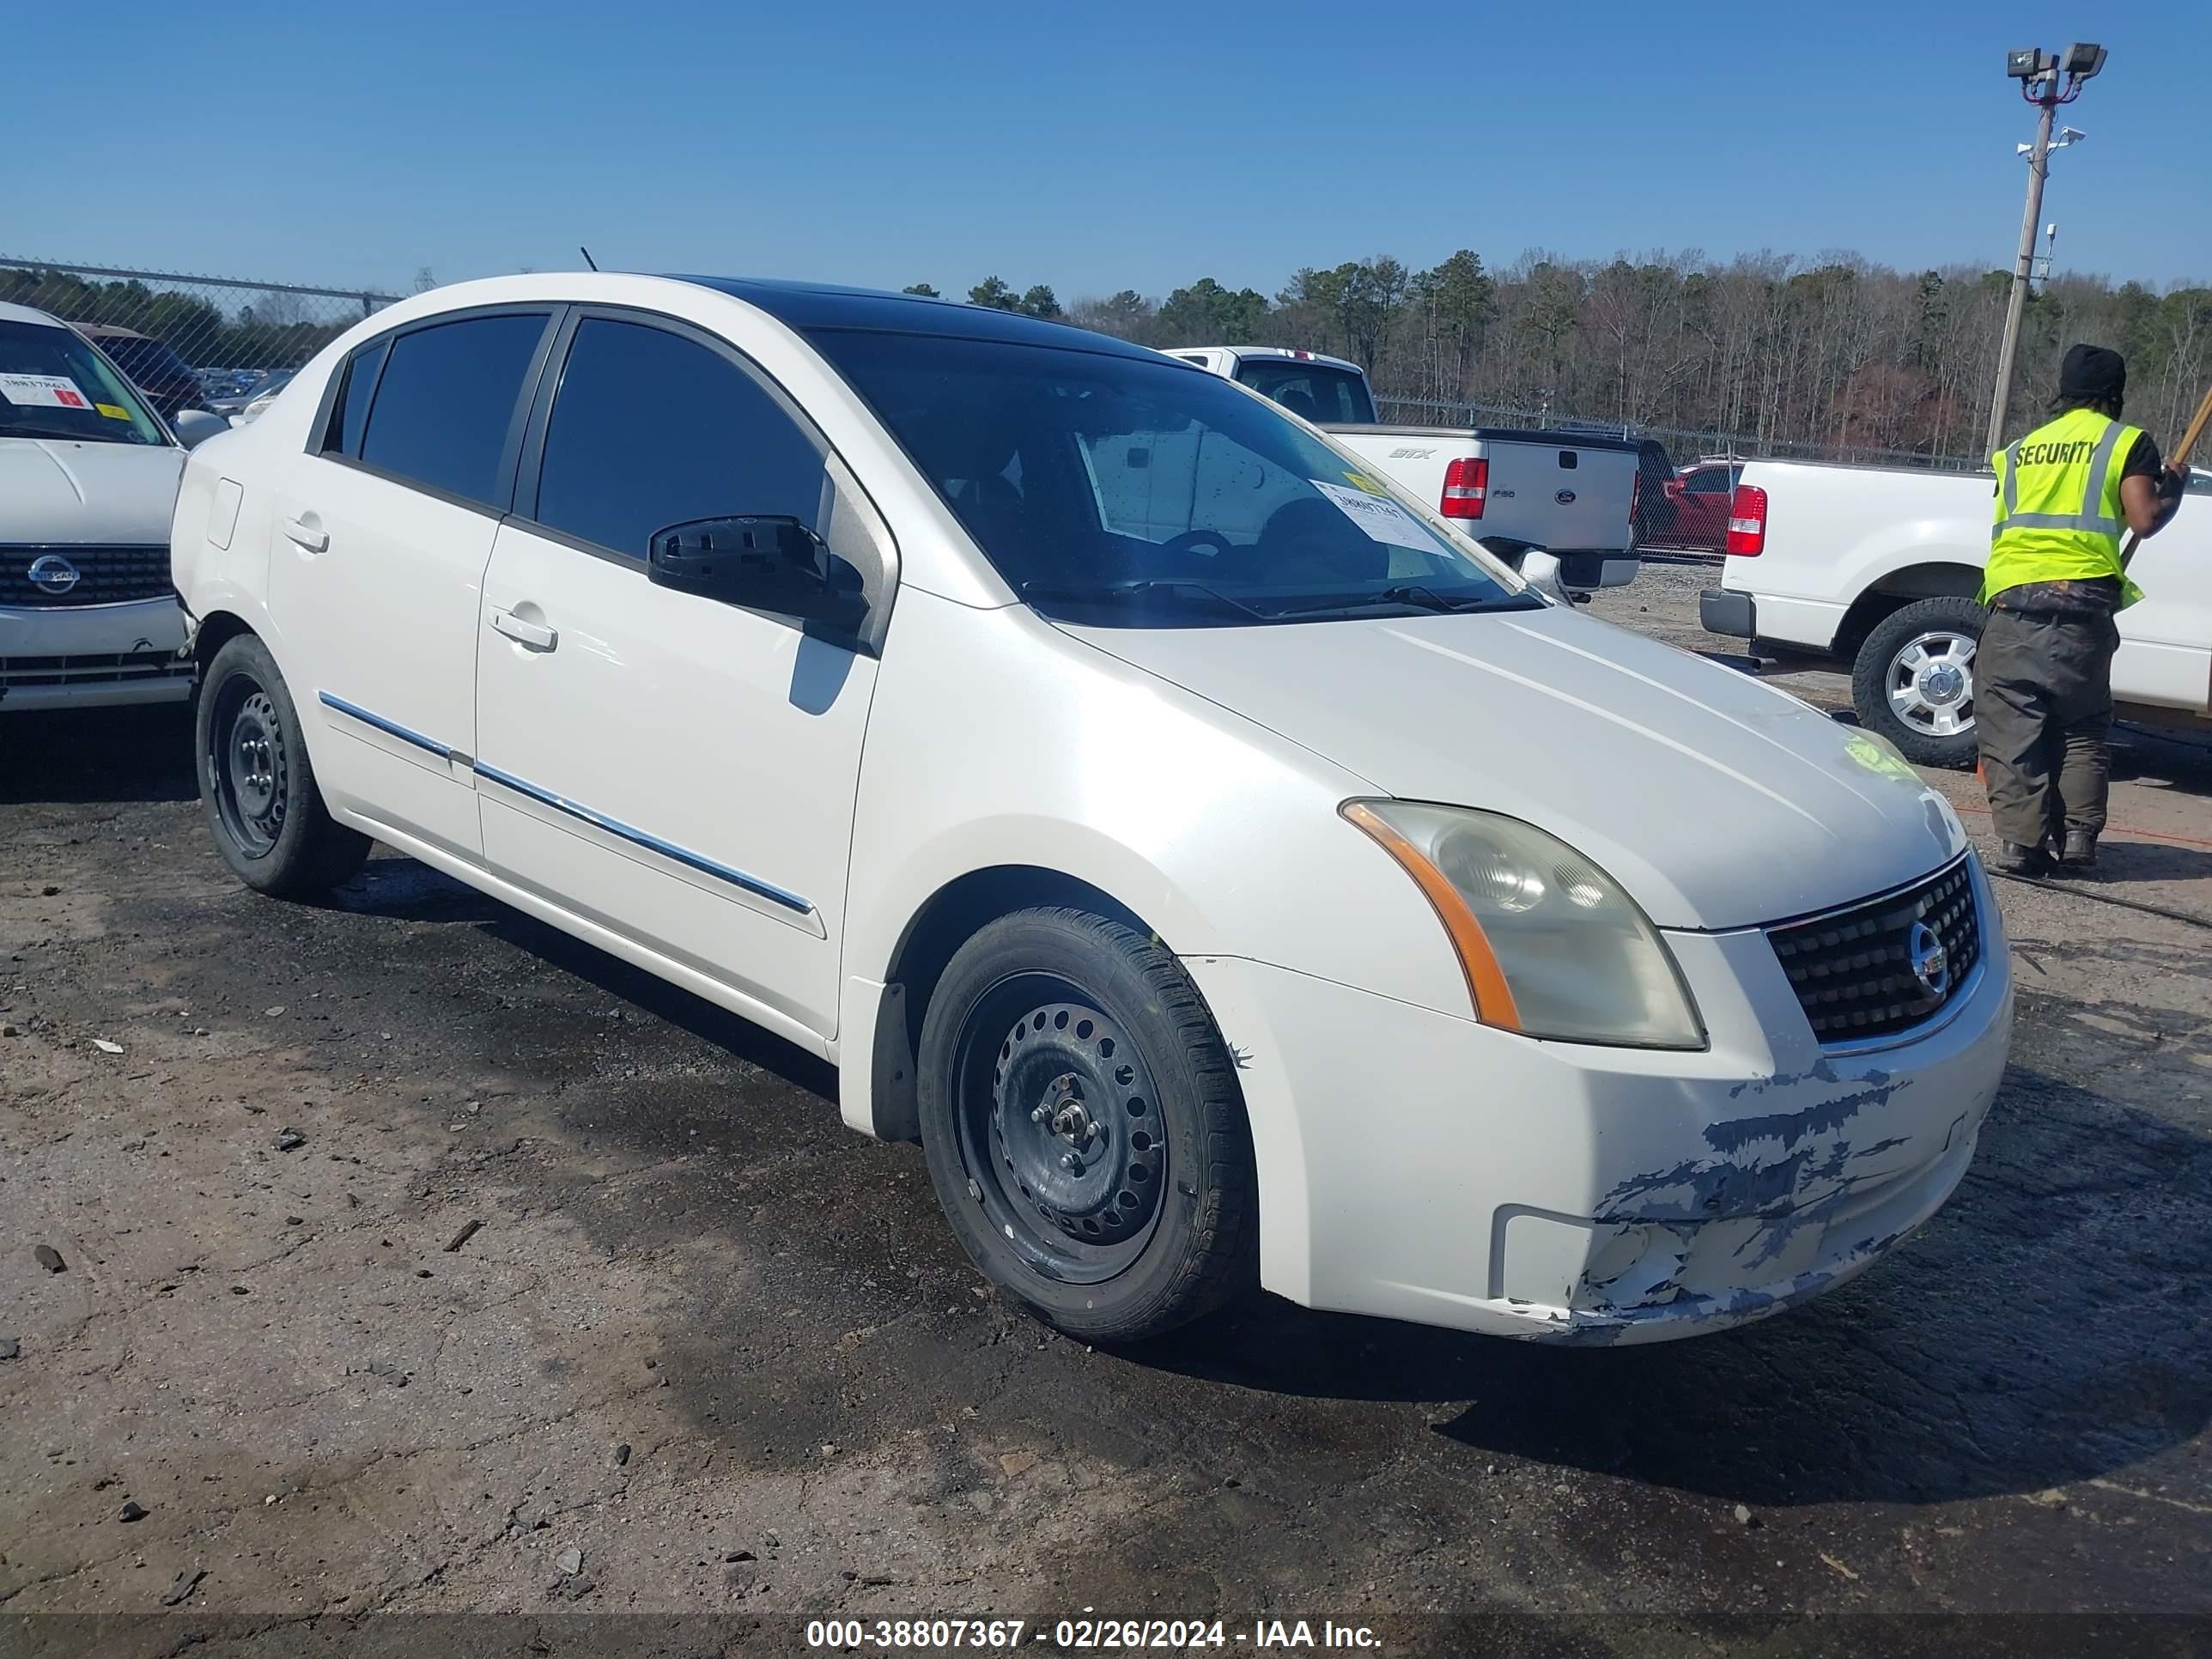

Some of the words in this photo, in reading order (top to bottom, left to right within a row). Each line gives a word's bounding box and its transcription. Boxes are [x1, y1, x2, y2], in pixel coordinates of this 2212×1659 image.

[1389, 448, 1437, 459] STX
[2014, 441, 2101, 469] SECURITY
[1334, 495, 1406, 520] 38807367
